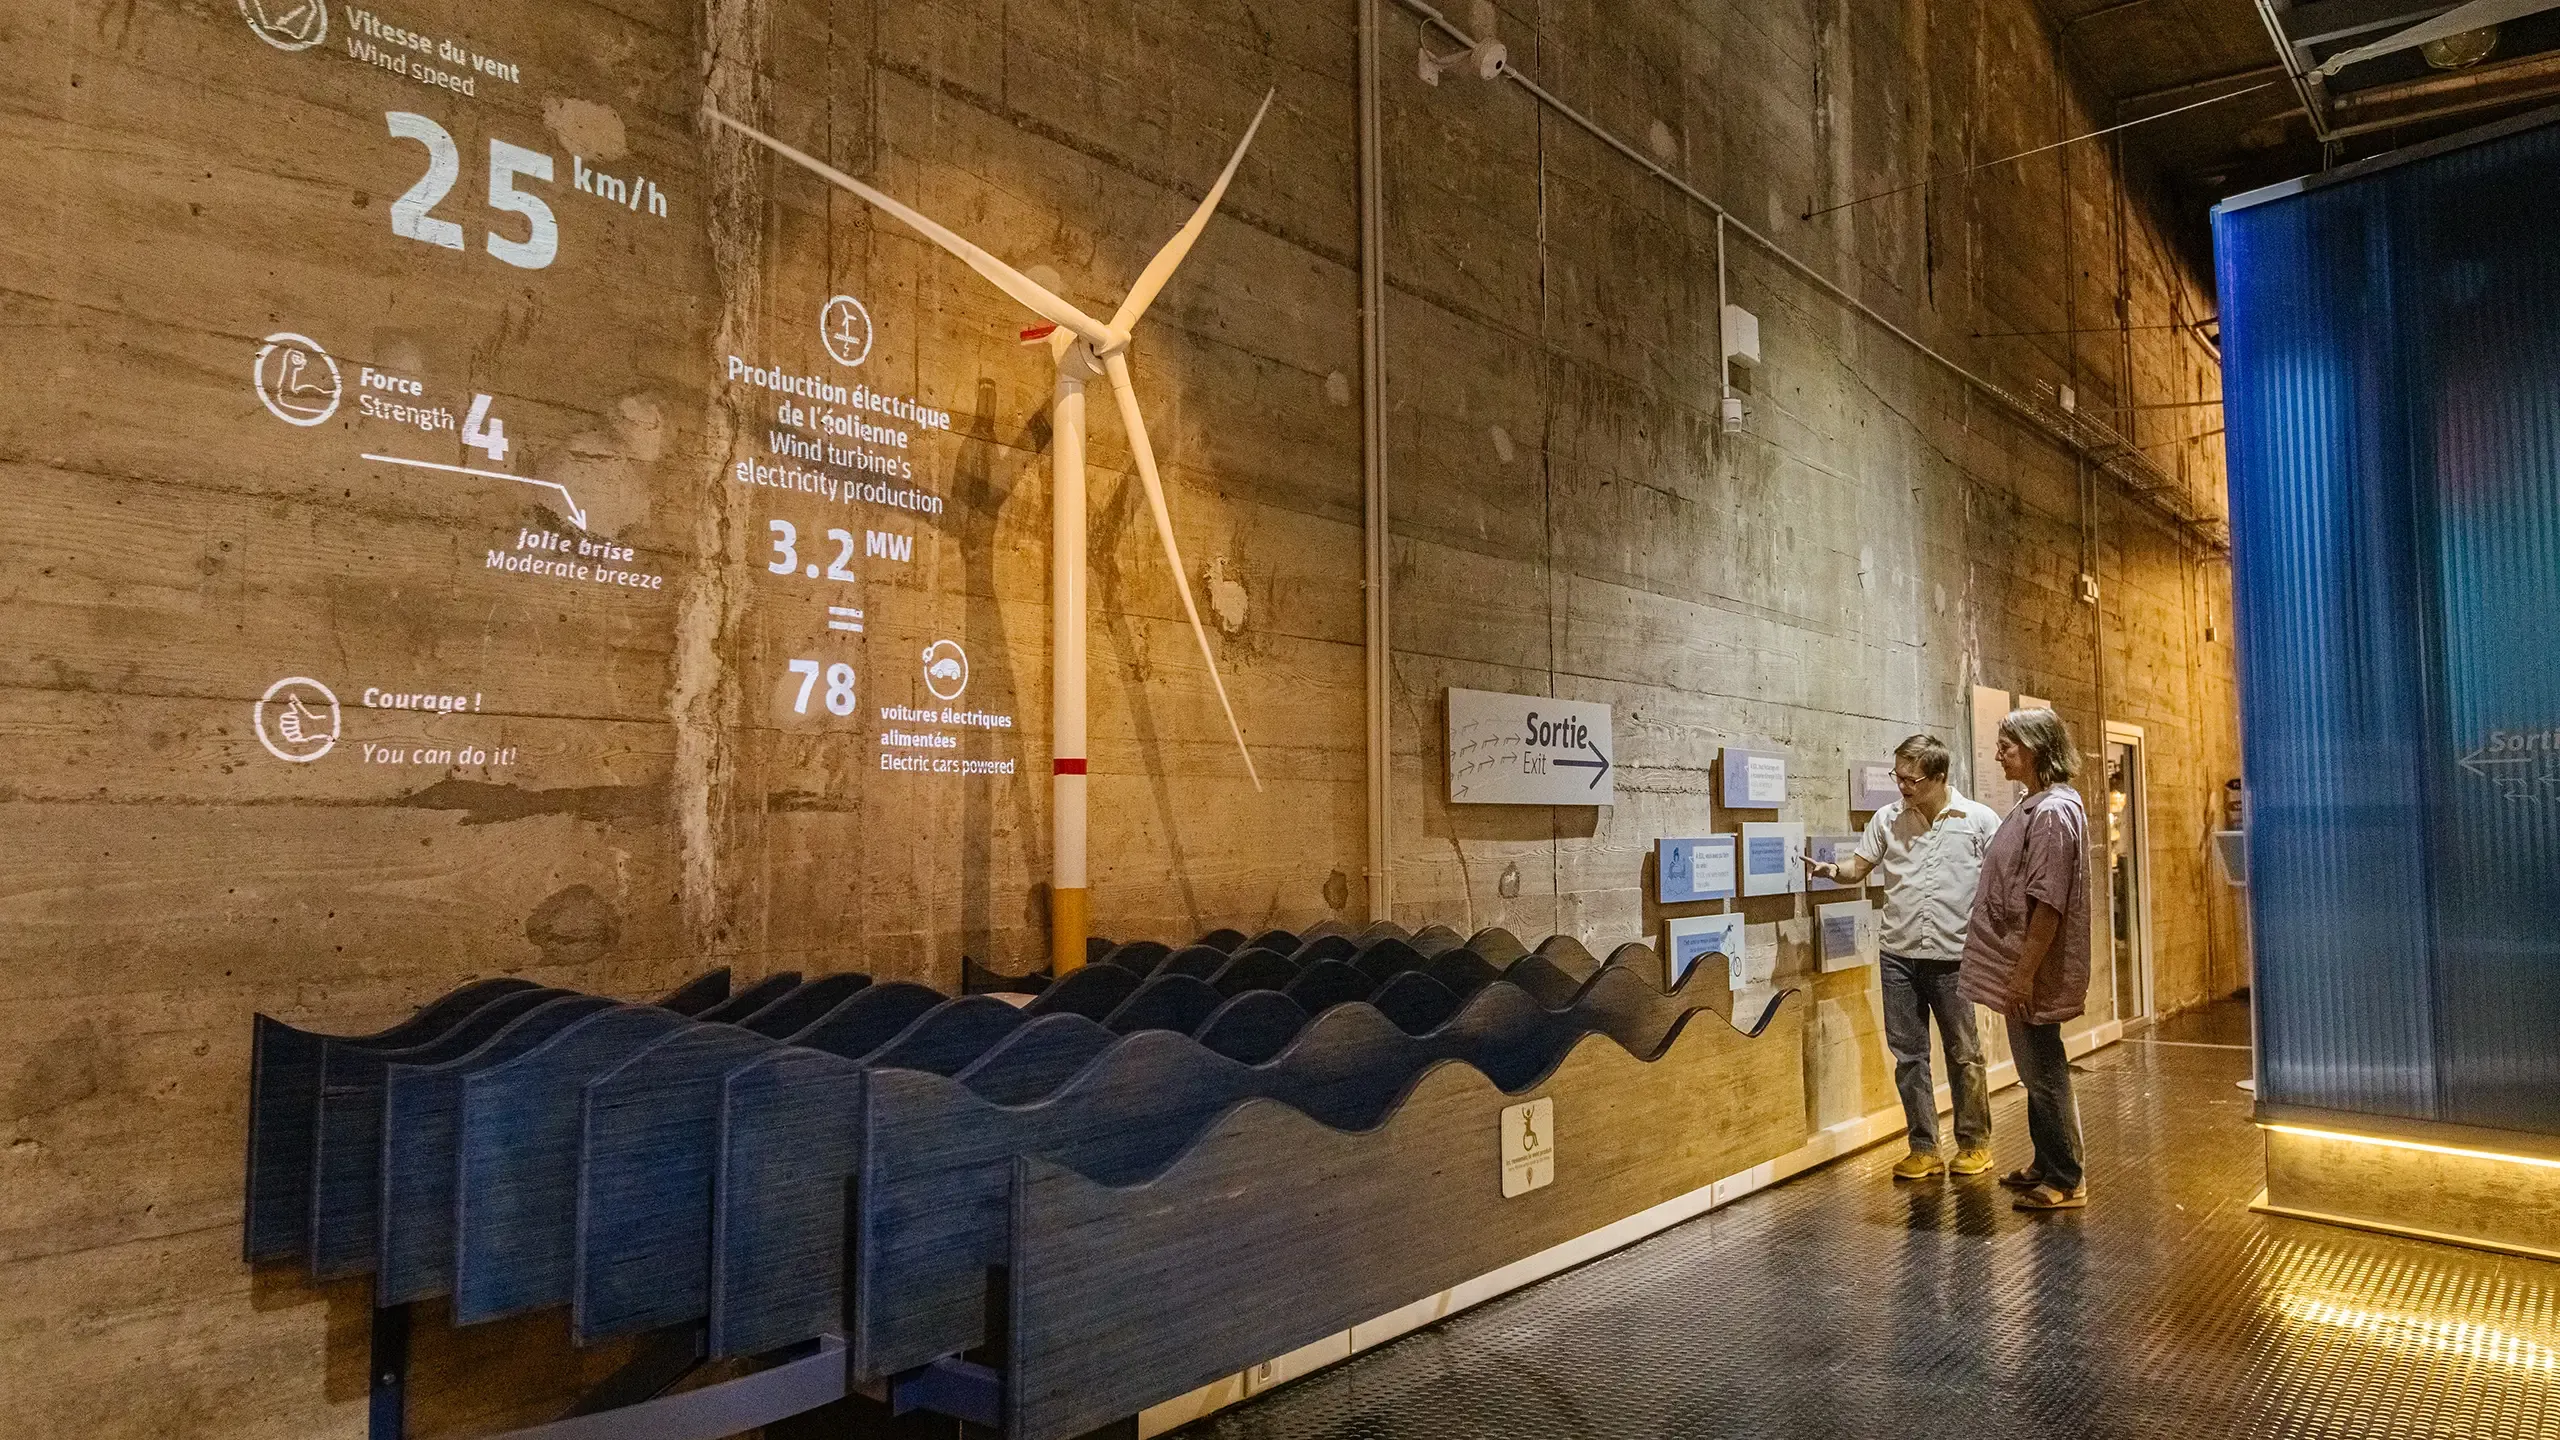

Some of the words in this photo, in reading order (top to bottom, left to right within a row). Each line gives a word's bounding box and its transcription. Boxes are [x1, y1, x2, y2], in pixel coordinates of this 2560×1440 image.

[346, 5, 433, 54] Vitesse
[438, 39, 466, 66] du
[472, 55, 520, 84] vent
[347, 37, 406, 76] Wind
[412, 63, 474, 98] speed
[385, 111, 559, 270] 25
[573, 156, 668, 218] km/h
[360, 367, 423, 397] Force
[728, 354, 847, 406] Production
[852, 384, 950, 431] électrique
[360, 395, 455, 432] Strength
[461, 393, 509, 460] 4
[778, 400, 804, 428] de
[810, 406, 908, 449] l'éolienne
[769, 431, 822, 462] Wind
[827, 443, 912, 479] turbine's
[736, 457, 838, 501] electricity
[843, 480, 943, 515] production
[516, 528, 573, 556] Jolie
[578, 538, 634, 562] brise
[768, 519, 855, 583] 3.2
[865, 530, 913, 562] MW
[486, 550, 590, 580] Moderate
[596, 565, 663, 589] breeze
[363, 687, 466, 715] Courage
[788, 658, 856, 716] 78
[881, 705, 938, 724] voitures
[941, 706, 1012, 728] électriques
[1525, 711, 1588, 749] Sortie
[362, 743, 405, 766] You
[413, 749, 451, 766] can
[459, 744, 486, 766] do
[494, 747, 517, 766] it!
[881, 729, 957, 748] alimentées
[881, 754, 930, 773] Electric
[933, 758, 960, 774] cars
[962, 758, 1014, 777] powered
[1523, 751, 1547, 775] Exit
